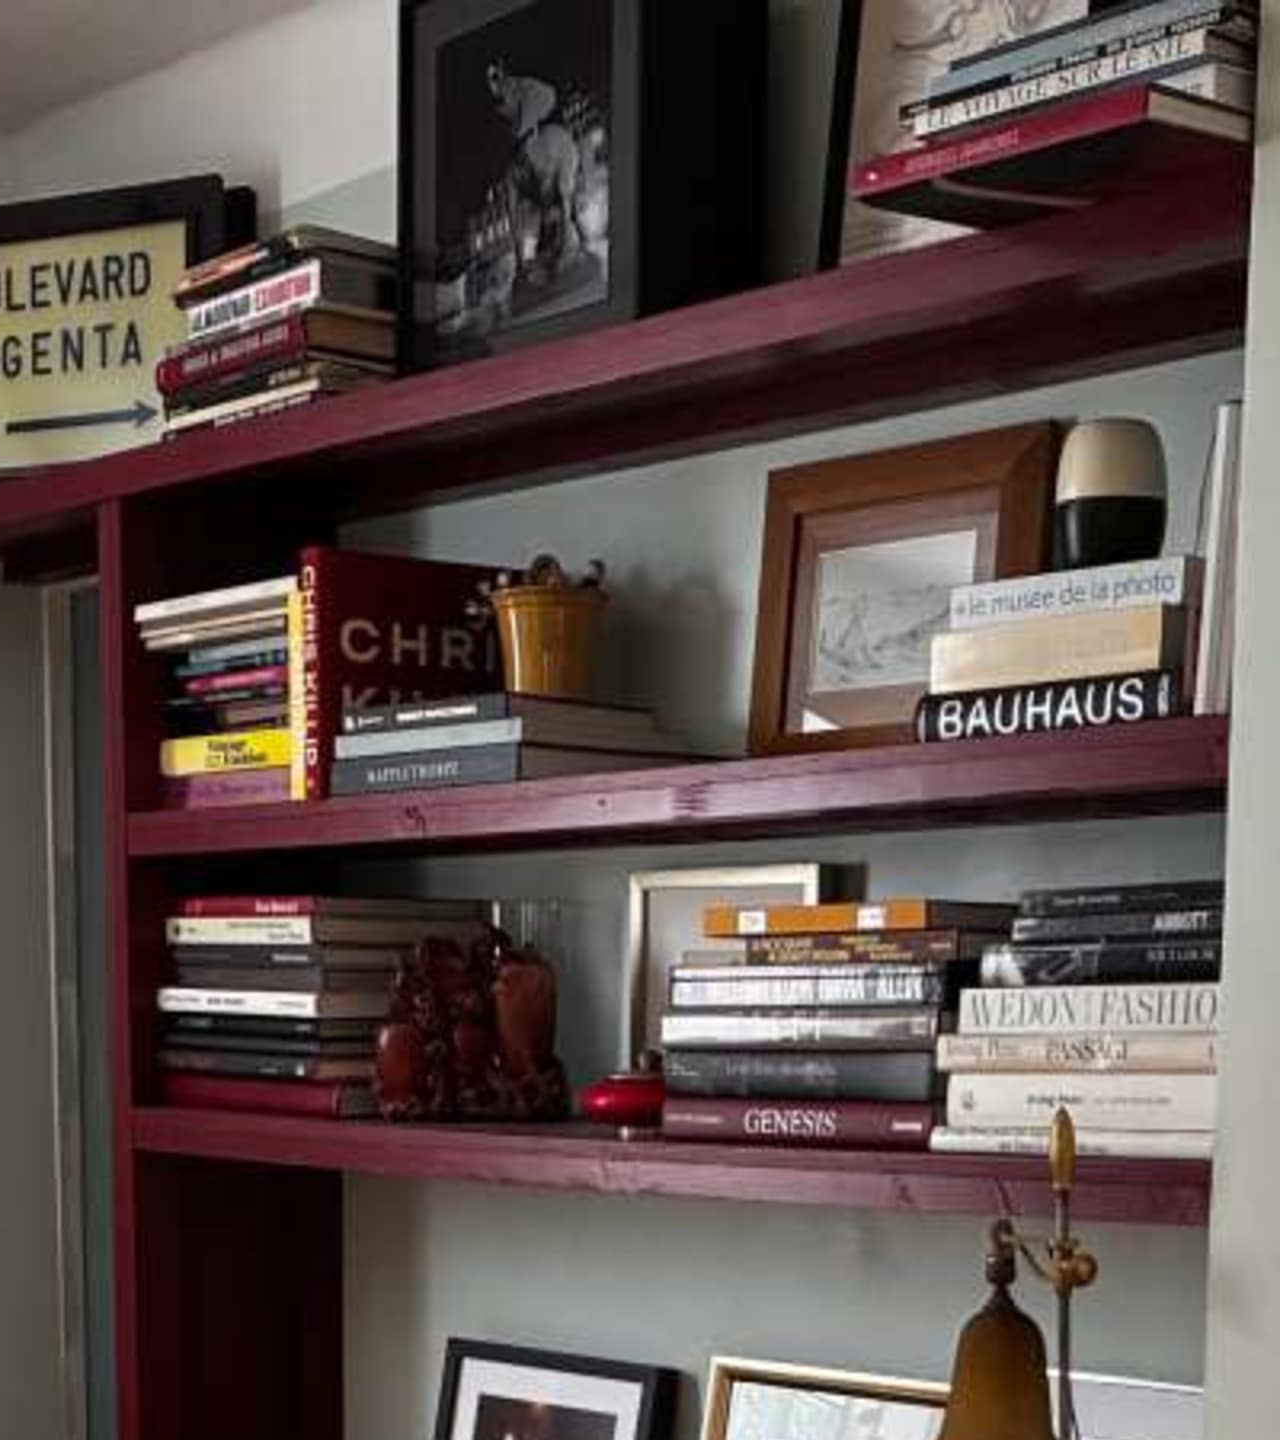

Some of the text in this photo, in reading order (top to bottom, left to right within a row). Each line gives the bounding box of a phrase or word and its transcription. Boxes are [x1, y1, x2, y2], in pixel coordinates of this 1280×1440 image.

[1059, 584, 1086, 607] de
[1112, 573, 1176, 606] photo
[302, 565, 319, 767] CHRIS KILLIP
[340, 618, 497, 673] CHRI
[937, 677, 1145, 741] BAUHAUS
[1099, 987, 1218, 1026] FASHIO
[744, 1109, 838, 1136] GENESIS
